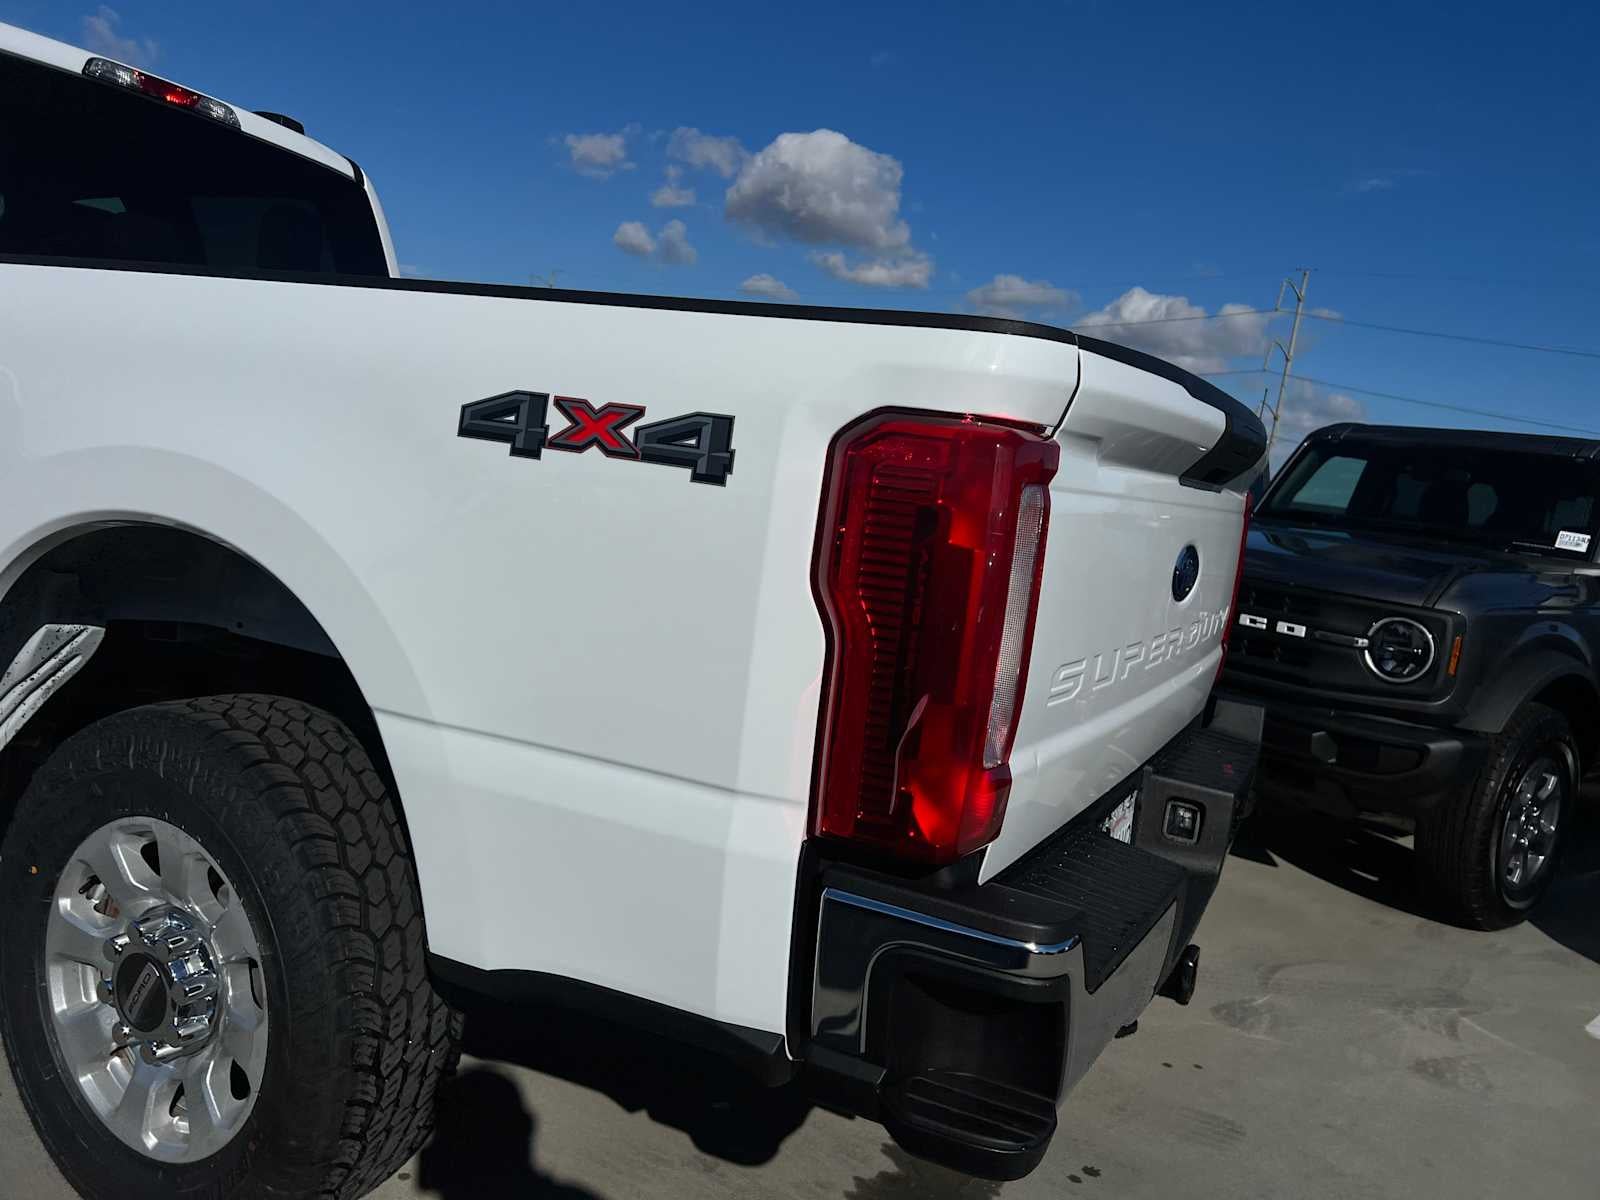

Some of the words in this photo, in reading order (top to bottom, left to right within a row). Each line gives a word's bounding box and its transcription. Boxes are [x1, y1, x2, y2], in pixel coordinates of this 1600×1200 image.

[457, 389, 736, 487] 4X4
[1047, 625, 1184, 707] SUPER
[128, 973, 151, 1013] FORD
